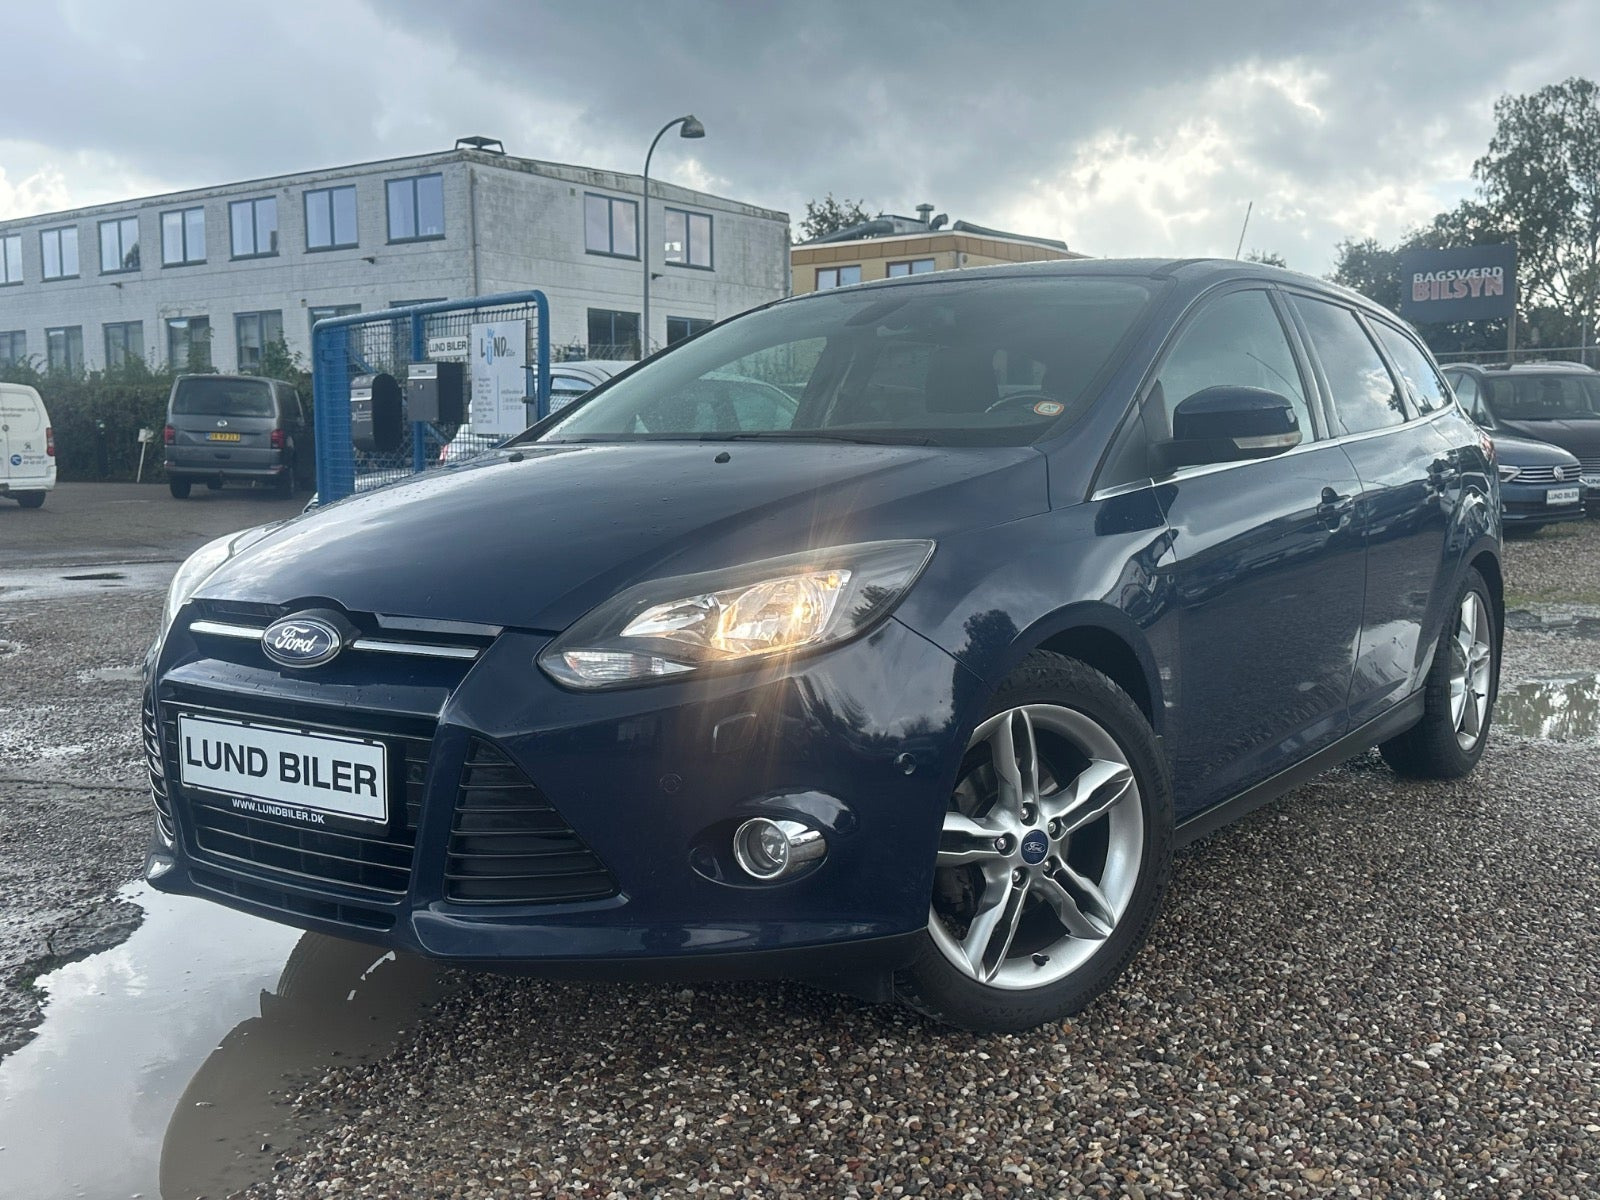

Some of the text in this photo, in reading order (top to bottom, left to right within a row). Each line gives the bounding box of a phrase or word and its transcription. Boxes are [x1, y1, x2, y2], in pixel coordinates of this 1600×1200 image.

[1413, 266, 1503, 284] BAGSVÆRD
[1412, 275, 1504, 302] BILSYN
[429, 341, 467, 352] LUND BILER
[275, 625, 317, 653] Ford
[186, 736, 378, 797] LUND BILER
[232, 798, 325, 824] WWW.LUNDBILER.DK
